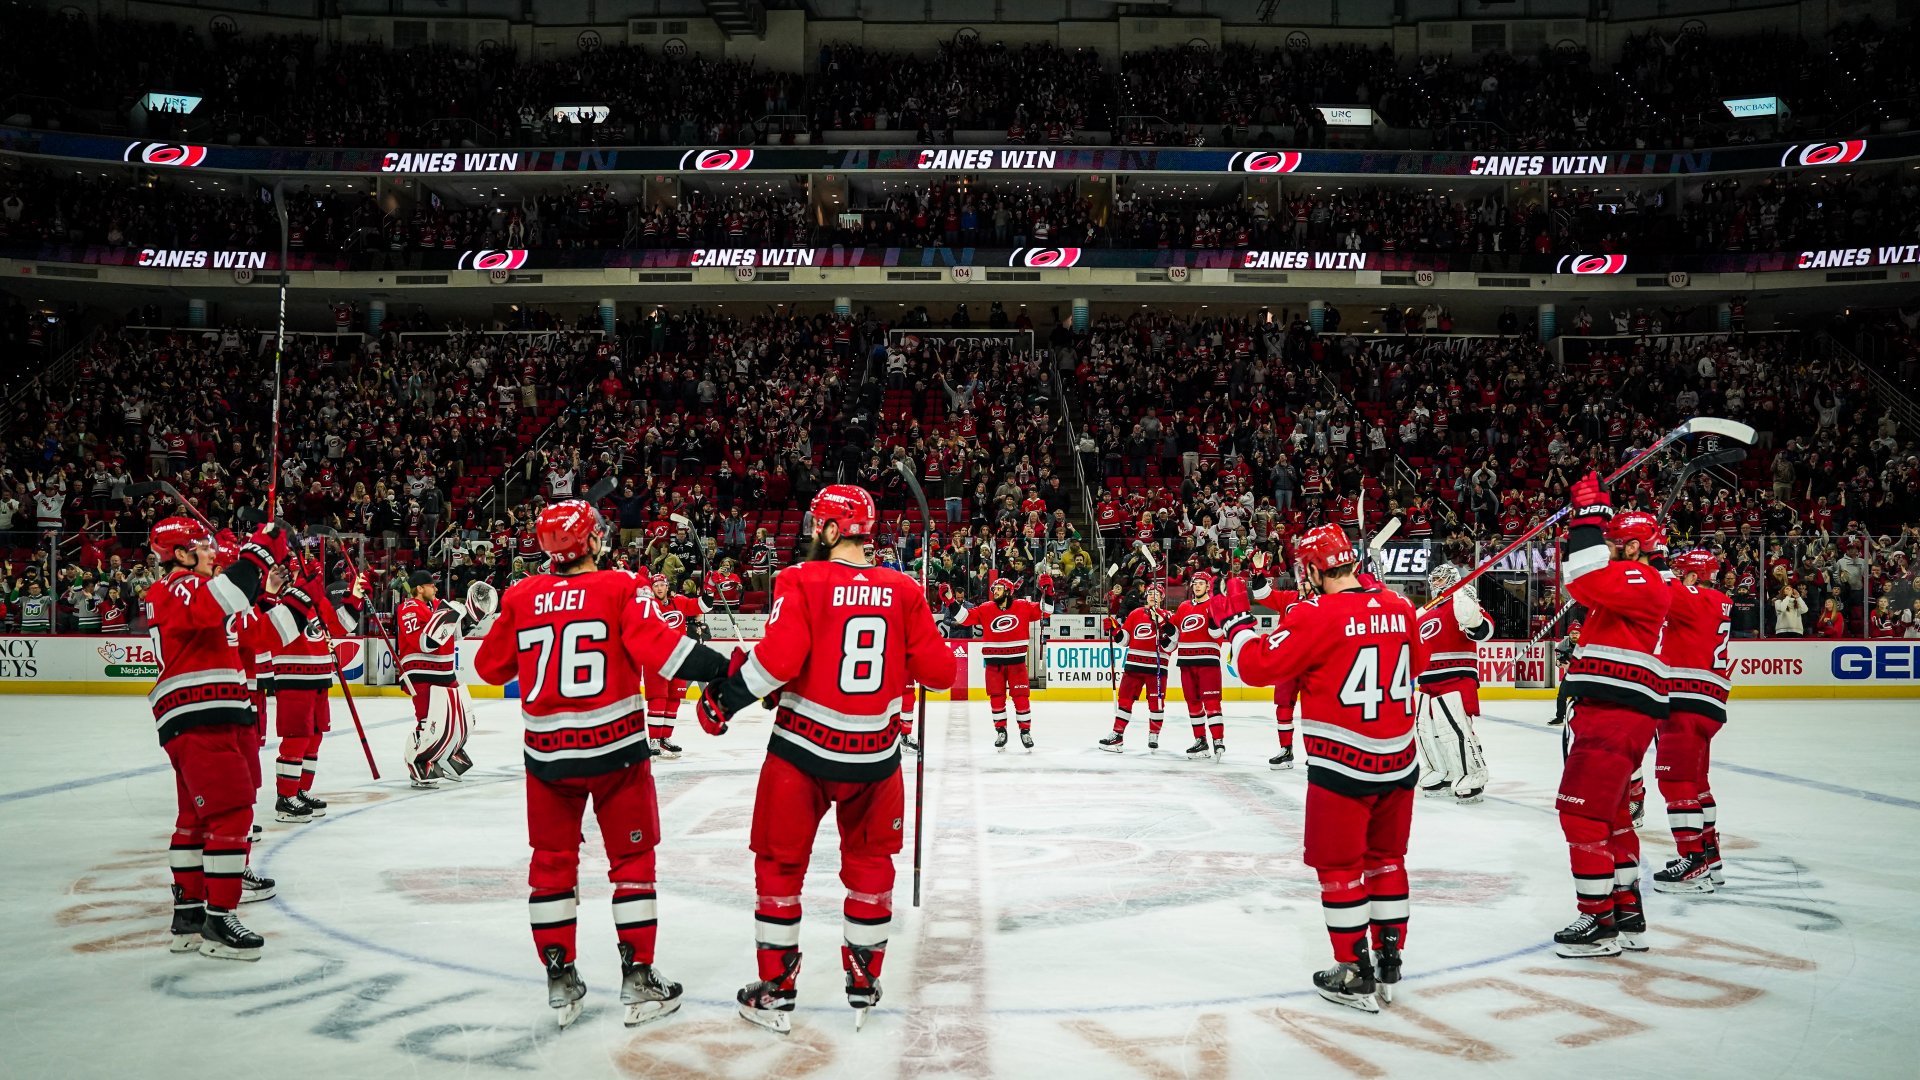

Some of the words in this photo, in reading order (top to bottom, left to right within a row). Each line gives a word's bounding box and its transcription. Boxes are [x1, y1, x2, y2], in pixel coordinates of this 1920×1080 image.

[581, 37, 598, 47] 303
[667, 46, 685, 55] 303
[1290, 43, 1307, 53] 305
[1331, 110, 1352, 118] UNC
[1734, 104, 1752, 112] PNC
[1753, 103, 1775, 111] BANK
[381, 153, 457, 172] CANES
[464, 153, 518, 171] WIN
[918, 150, 993, 169] CANES
[1000, 151, 1056, 168] WIN
[1470, 156, 1544, 175] CANES
[1552, 156, 1608, 174] WIN
[138, 249, 207, 268] CANES
[213, 251, 266, 268] WIN
[690, 249, 756, 266] CANES
[761, 249, 815, 266] WIN
[1244, 251, 1308, 268] CANES
[1314, 251, 1367, 269] WIN
[1799, 248, 1872, 268] CANES
[1879, 245, 1920, 264] WI
[237, 271, 250, 279] 101
[492, 271, 506, 279] 102
[738, 269, 753, 277] 103
[955, 269, 970, 277] 104
[1171, 269, 1185, 277] 105
[1418, 273, 1432, 281] 106
[1671, 275, 1685, 283] 107
[1379, 549, 1431, 573] NES
[174, 576, 200, 606] 37
[832, 585, 893, 607] BURNS
[534, 589, 586, 615] SKJEI
[769, 597, 784, 625] 8
[404, 618, 421, 634] 32
[1345, 617, 1366, 637] de
[1370, 614, 1407, 634] HAAN
[517, 620, 609, 703] 76
[838, 615, 889, 695] 8
[1478, 647, 1517, 659] CLEA
[1741, 658, 1803, 676] SPORTS
[1058, 672, 1091, 681] TEAM
[1096, 672, 1124, 681] DOC
[1339, 643, 1412, 721] 44
[1682, 864, 1709, 881] CCM
[848, 954, 864, 977] CCM
